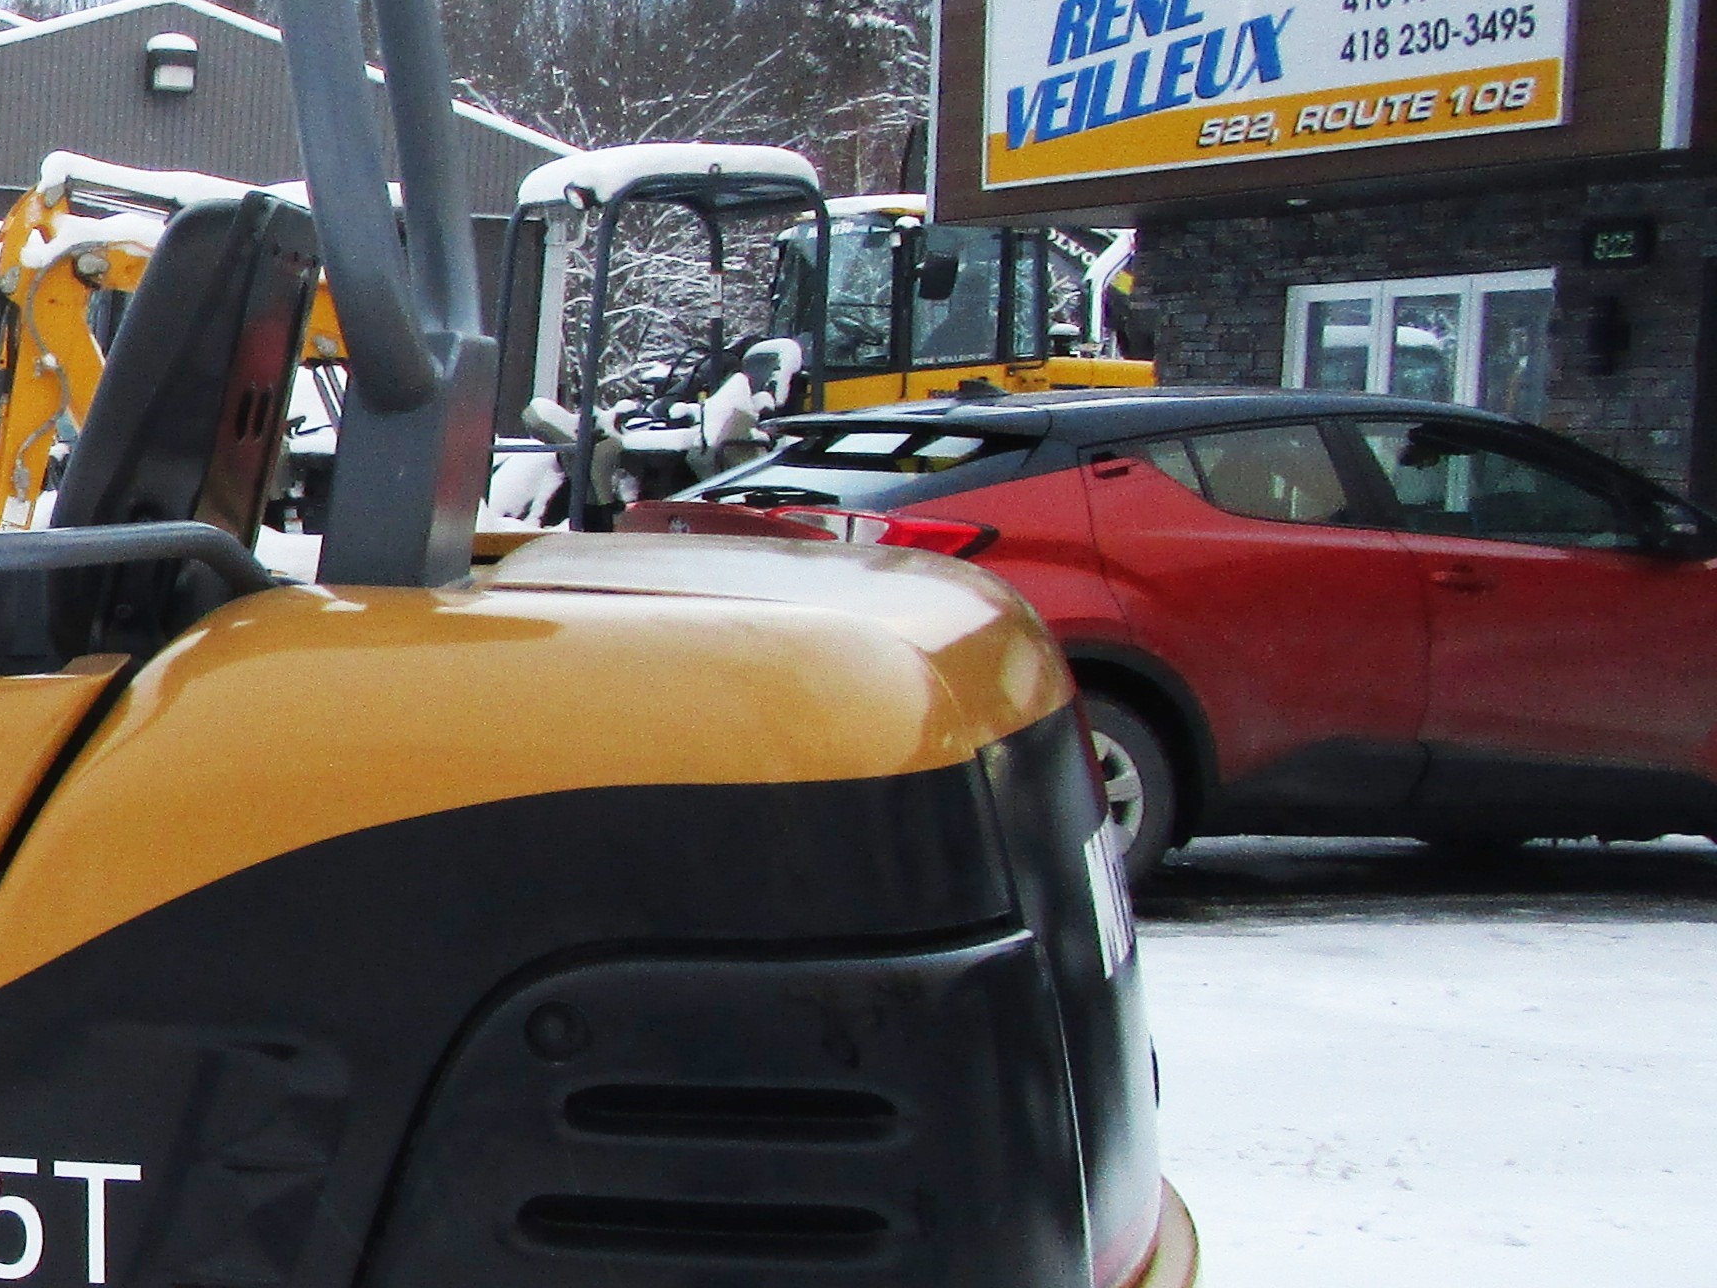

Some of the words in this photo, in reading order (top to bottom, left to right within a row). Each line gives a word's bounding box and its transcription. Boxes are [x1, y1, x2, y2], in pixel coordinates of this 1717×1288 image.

[1340, 27, 1390, 63] 418
[1399, 4, 1537, 56] 230-3495
[1006, 7, 1295, 150] VEILLEUX
[1196, 111, 1280, 148] 522,
[1292, 89, 1438, 138] ROUTE
[1447, 77, 1537, 117] 108
[1047, 227, 1098, 266] OLVO
